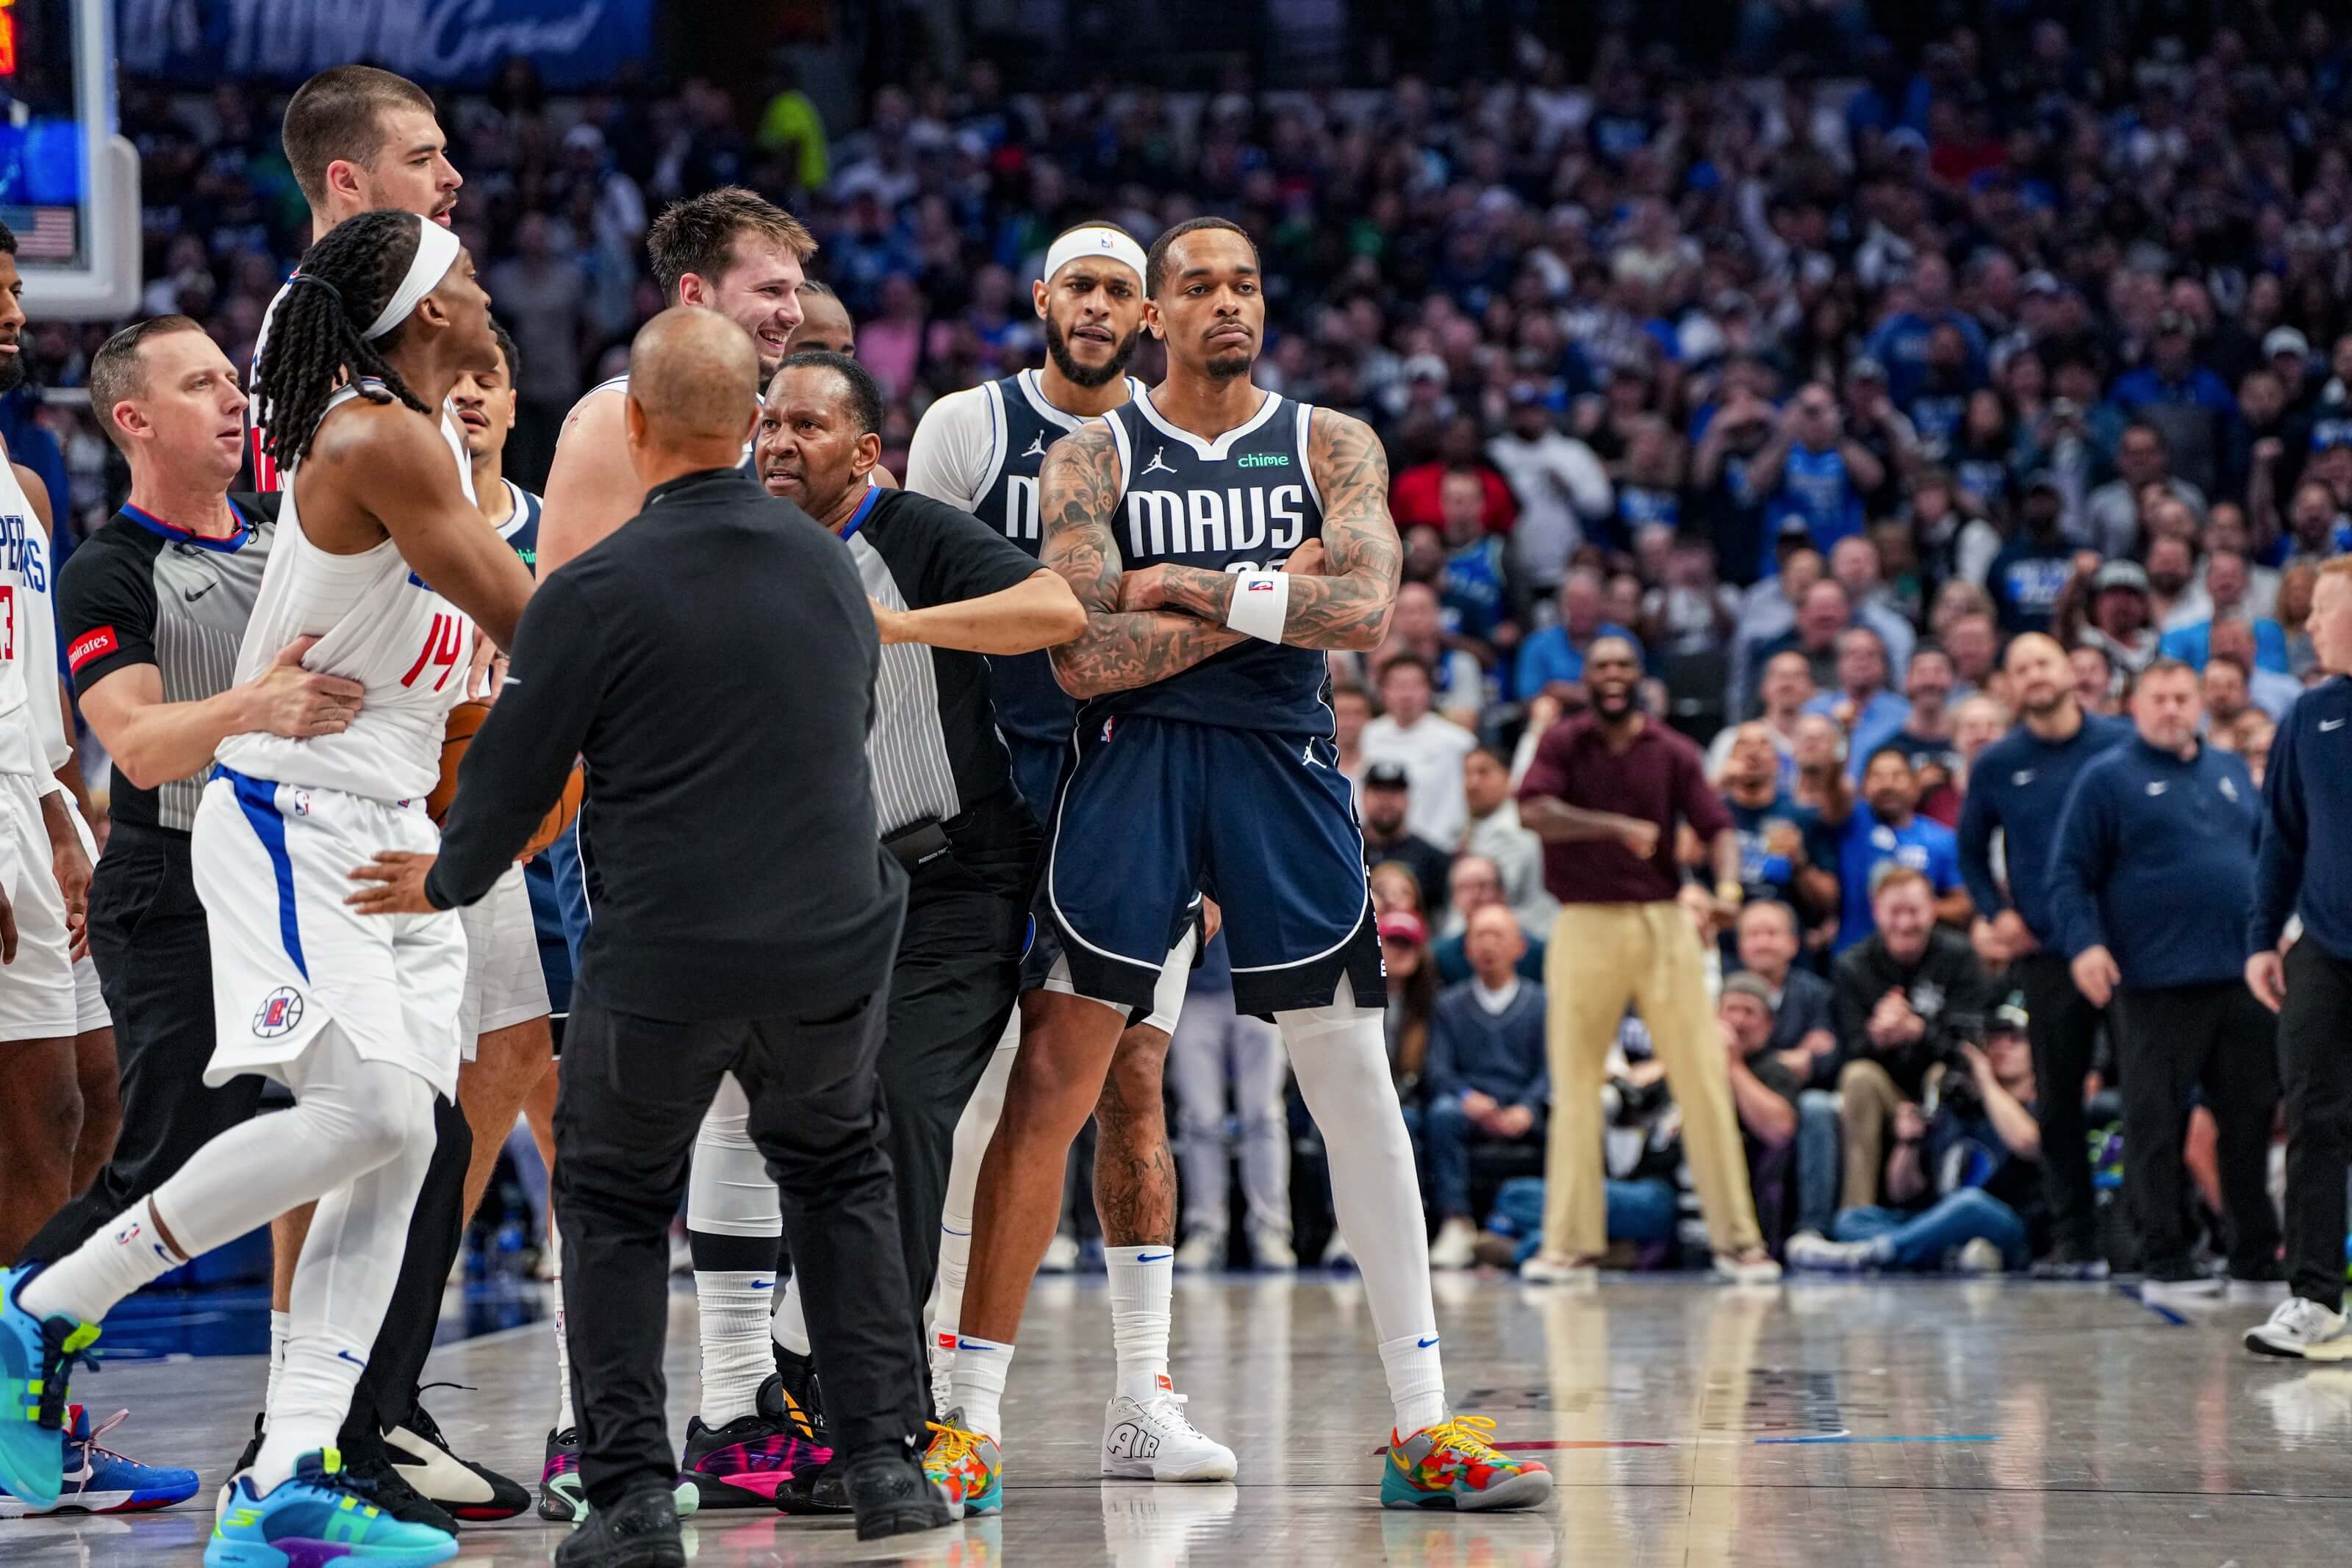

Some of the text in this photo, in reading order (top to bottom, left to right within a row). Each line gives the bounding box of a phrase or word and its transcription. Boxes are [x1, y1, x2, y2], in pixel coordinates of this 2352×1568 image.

[1238, 453, 1289, 468] chime
[1126, 484, 1304, 558] MAVS
[401, 612, 463, 692] 14
[1106, 1423, 1160, 1459] AIR
